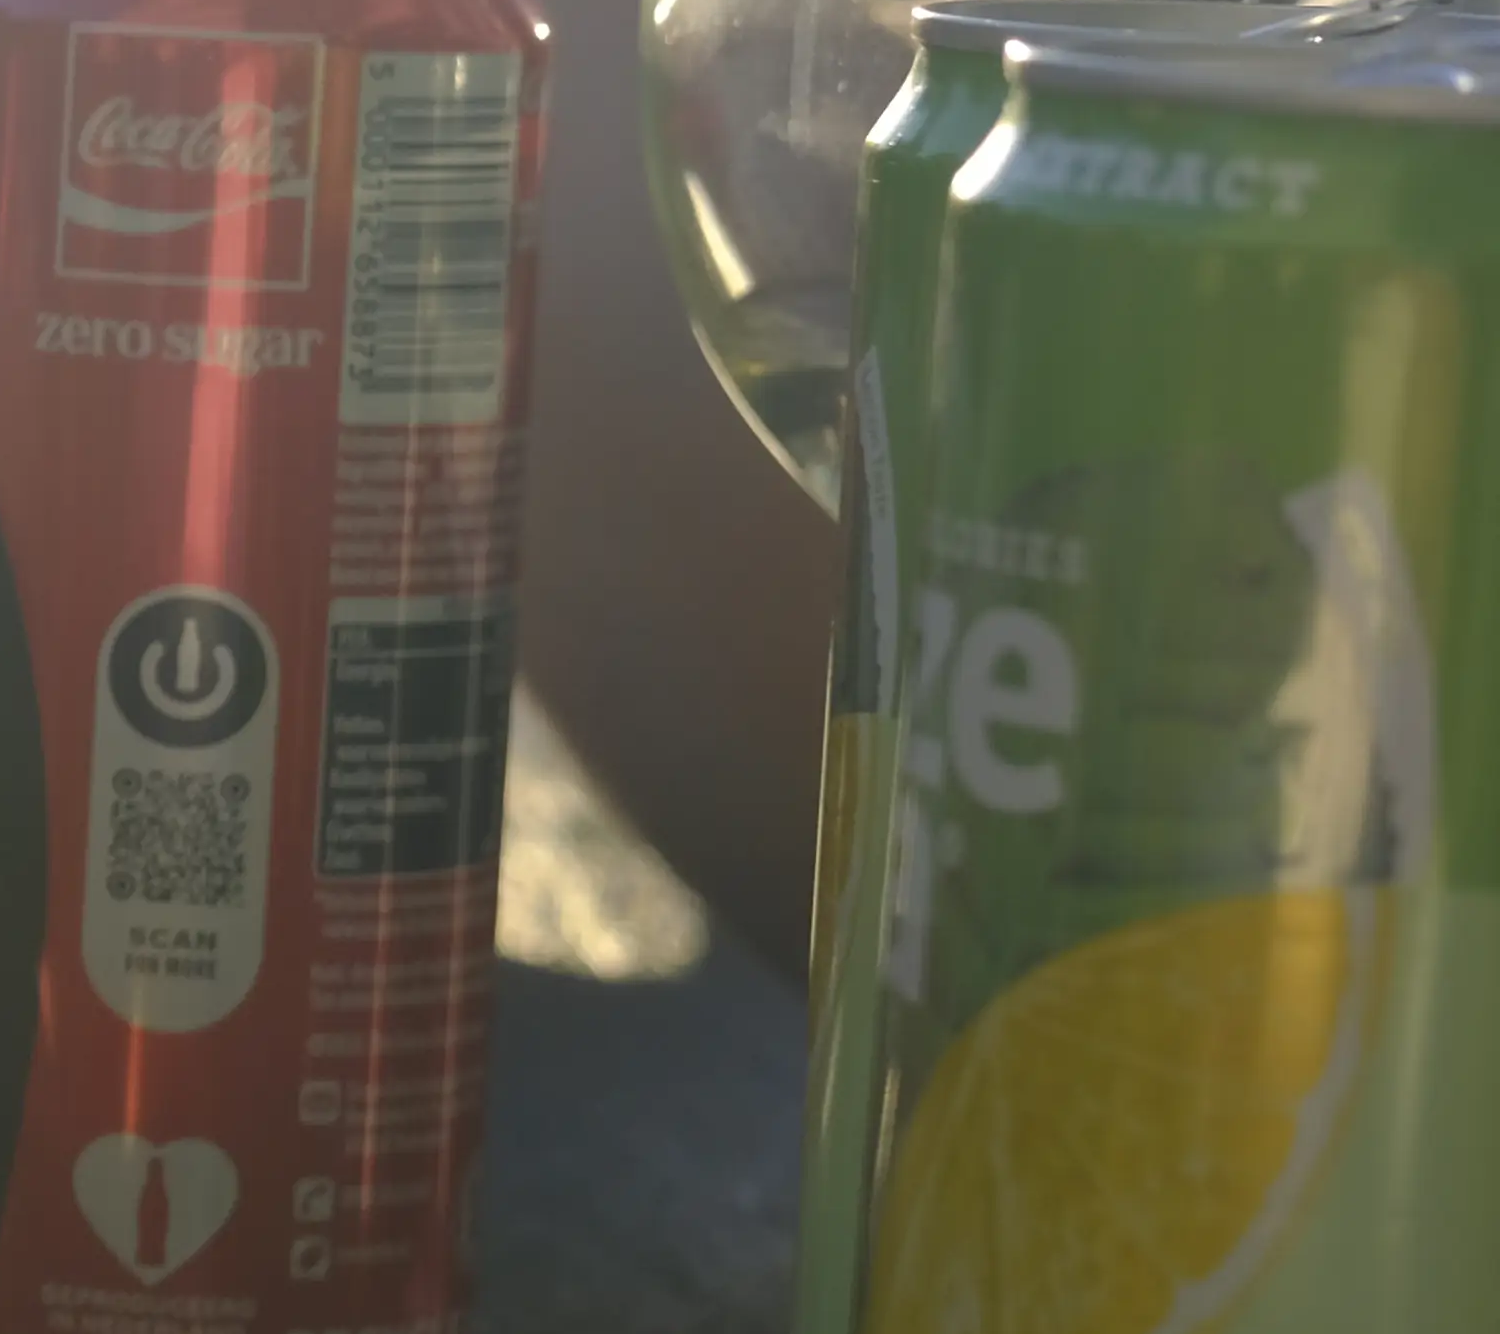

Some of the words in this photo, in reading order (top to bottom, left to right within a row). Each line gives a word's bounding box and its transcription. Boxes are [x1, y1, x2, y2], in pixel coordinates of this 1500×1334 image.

[77, 95, 310, 177] Coca-Cola
[34, 311, 153, 360] zero
[163, 321, 323, 379] sugar
[129, 926, 218, 952] SCAN
